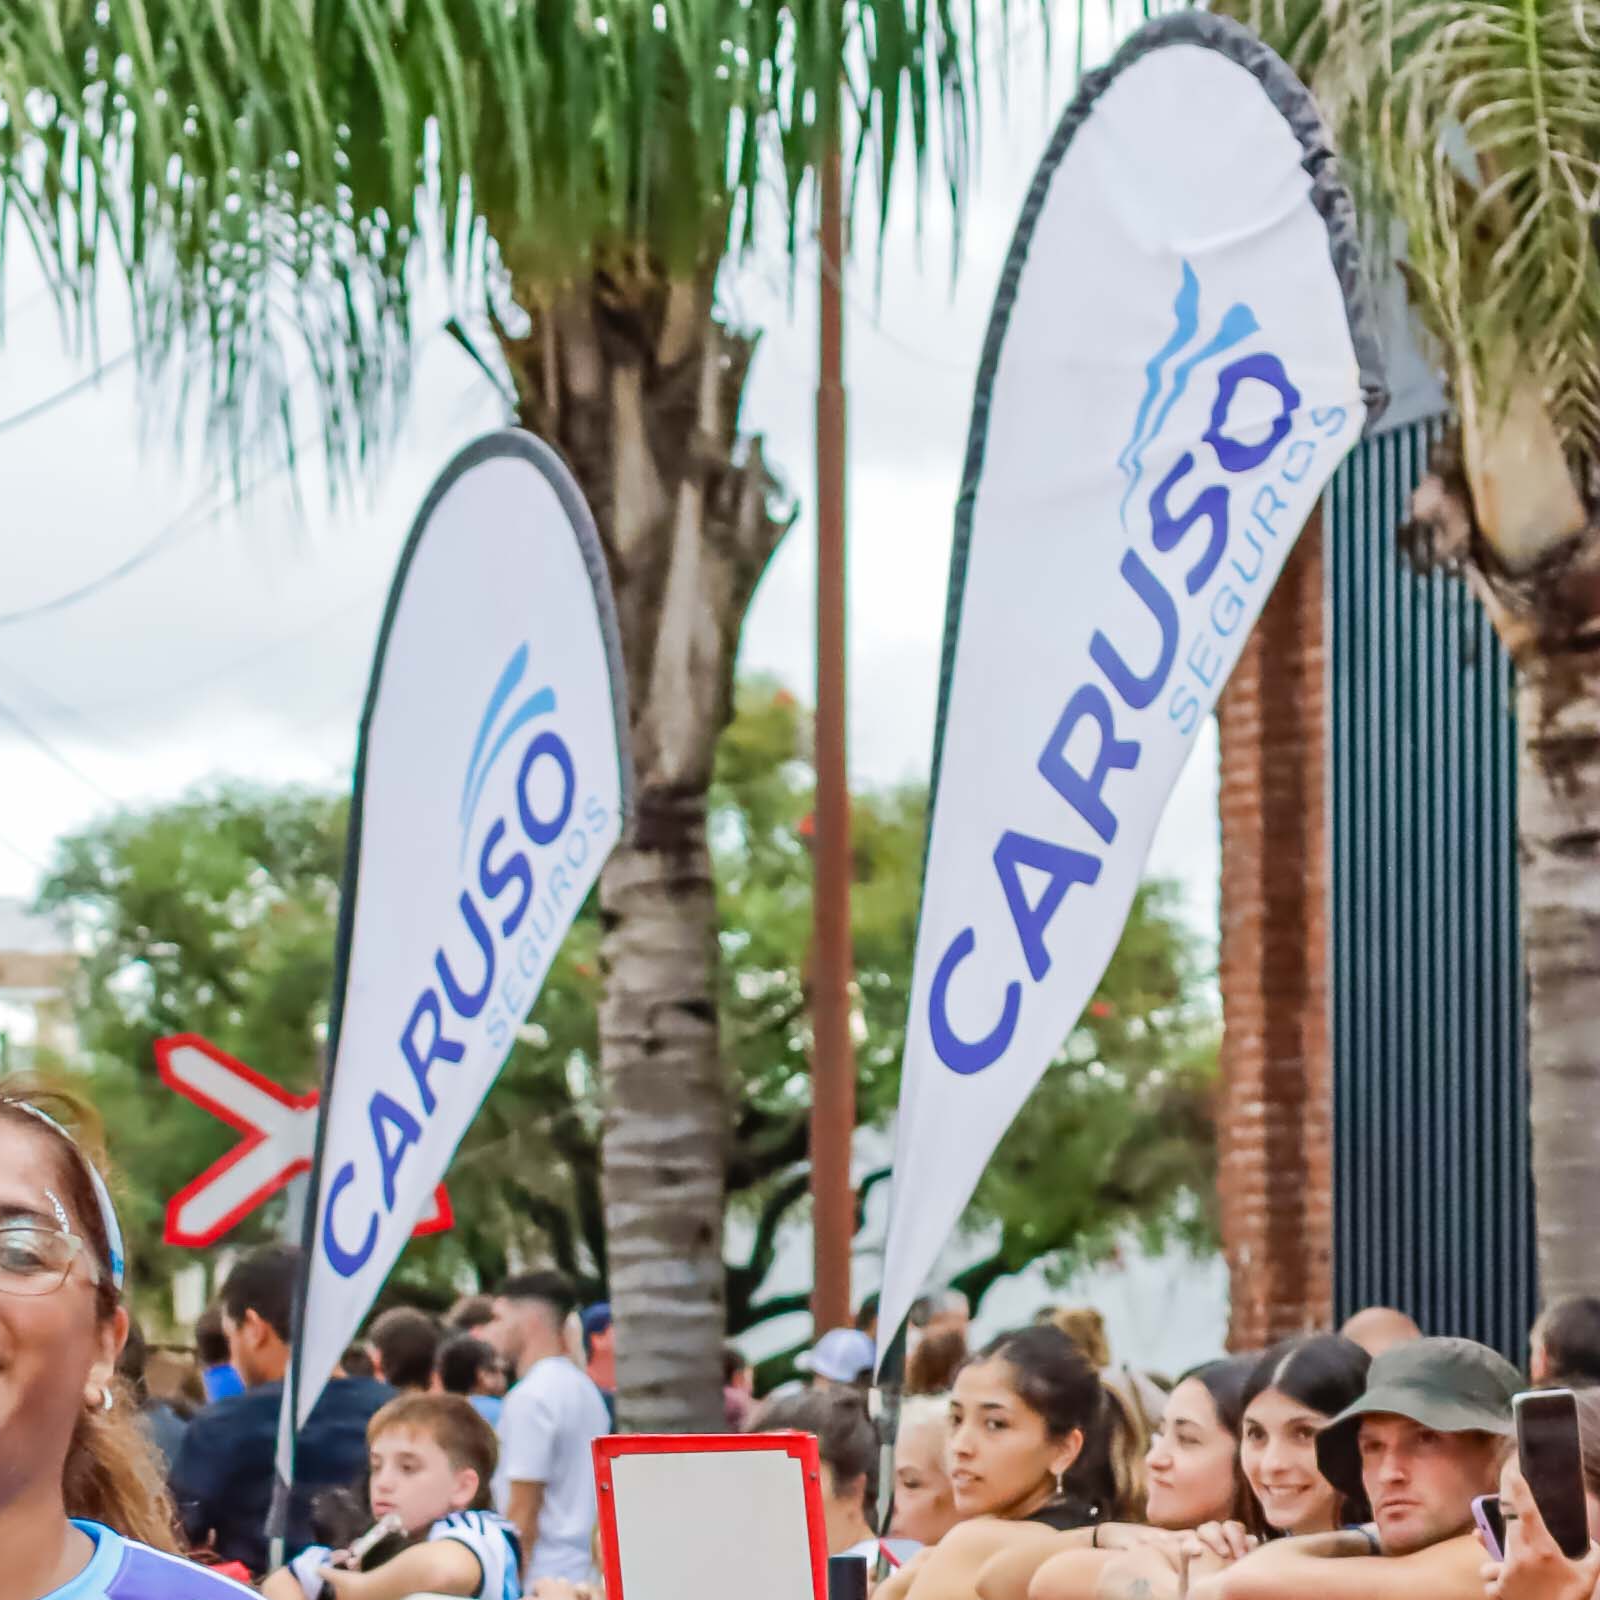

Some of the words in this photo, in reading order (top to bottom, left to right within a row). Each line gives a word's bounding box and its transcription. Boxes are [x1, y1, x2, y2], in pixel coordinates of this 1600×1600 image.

[929, 353, 1300, 1076] CARUSO
[1168, 404, 1347, 735] SEGUROS
[322, 731, 575, 1278] CARUSO
[485, 795, 610, 1050] SEGUROS
